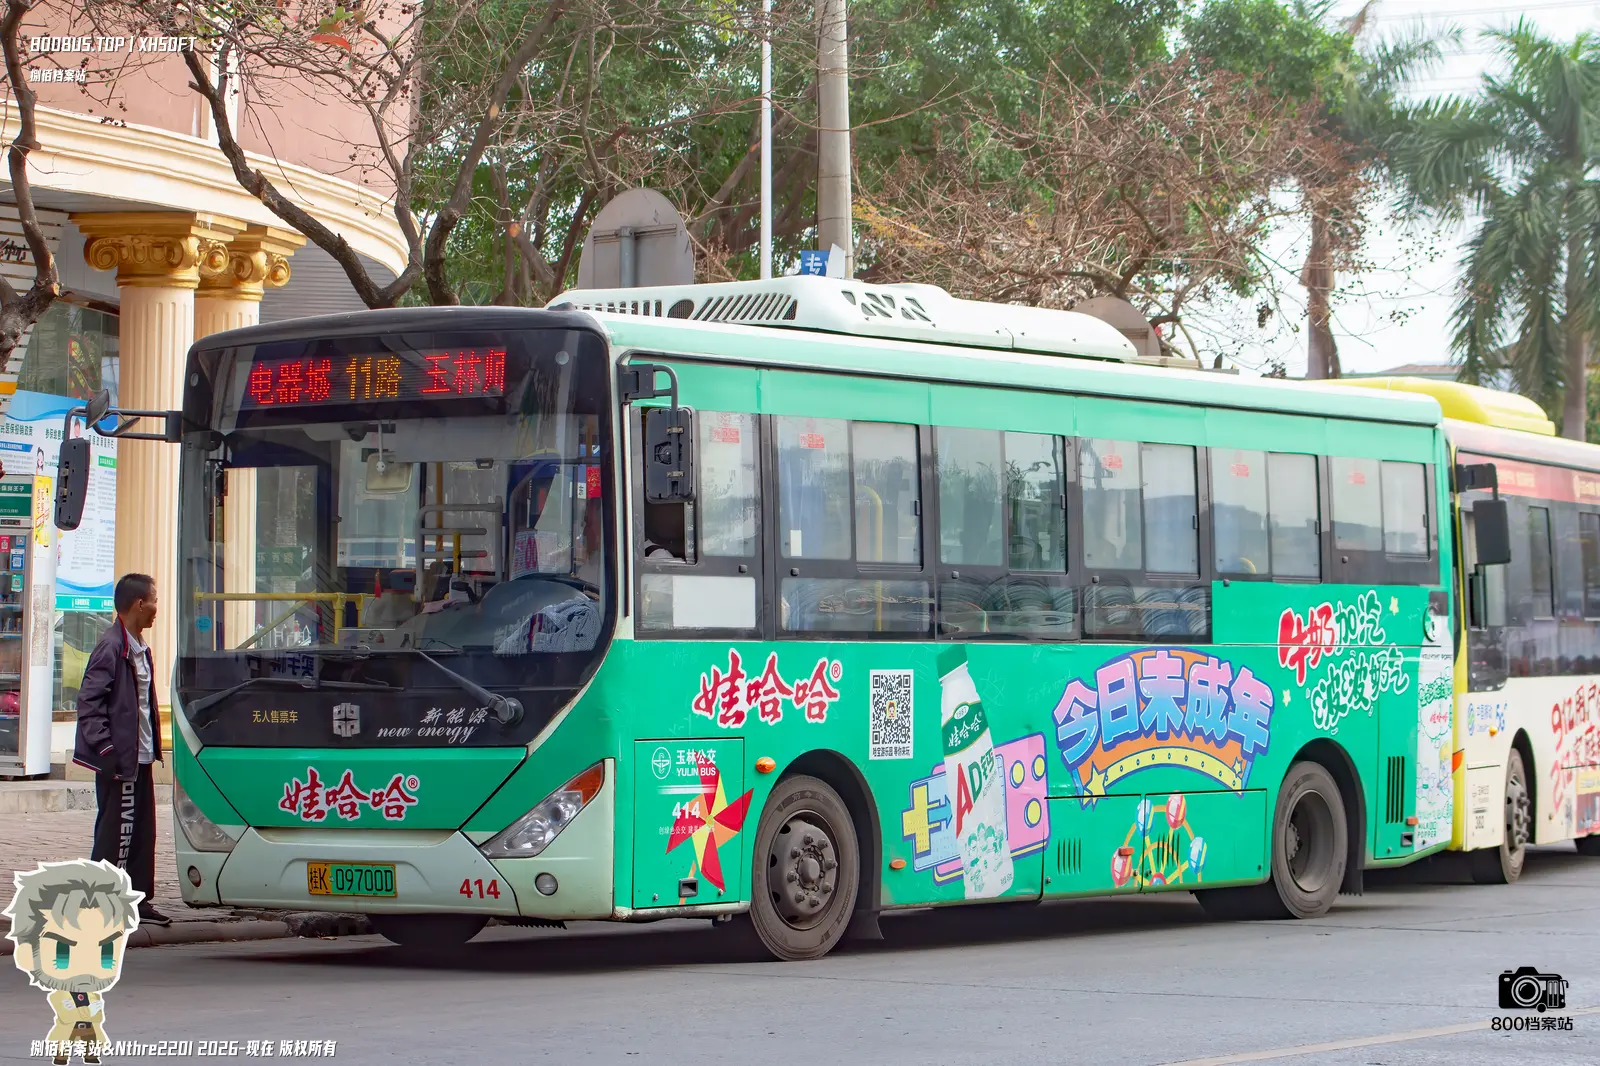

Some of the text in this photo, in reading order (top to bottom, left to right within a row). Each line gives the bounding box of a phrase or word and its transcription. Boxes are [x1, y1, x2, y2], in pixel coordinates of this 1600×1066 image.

[251, 359, 332, 404] 电器城
[345, 355, 402, 400] 11路
[420, 707, 488, 724] 新能源
[1056, 649, 1274, 765] 今日未成年
[252, 710, 298, 723] 无人售票车
[377, 725, 478, 744] new energy
[676, 748, 716, 765] 玉林公交
[676, 767, 716, 777] YULIN BUS
[672, 801, 700, 819] 414
[117, 781, 135, 870] ONVERSE
[459, 878, 501, 899] 414
